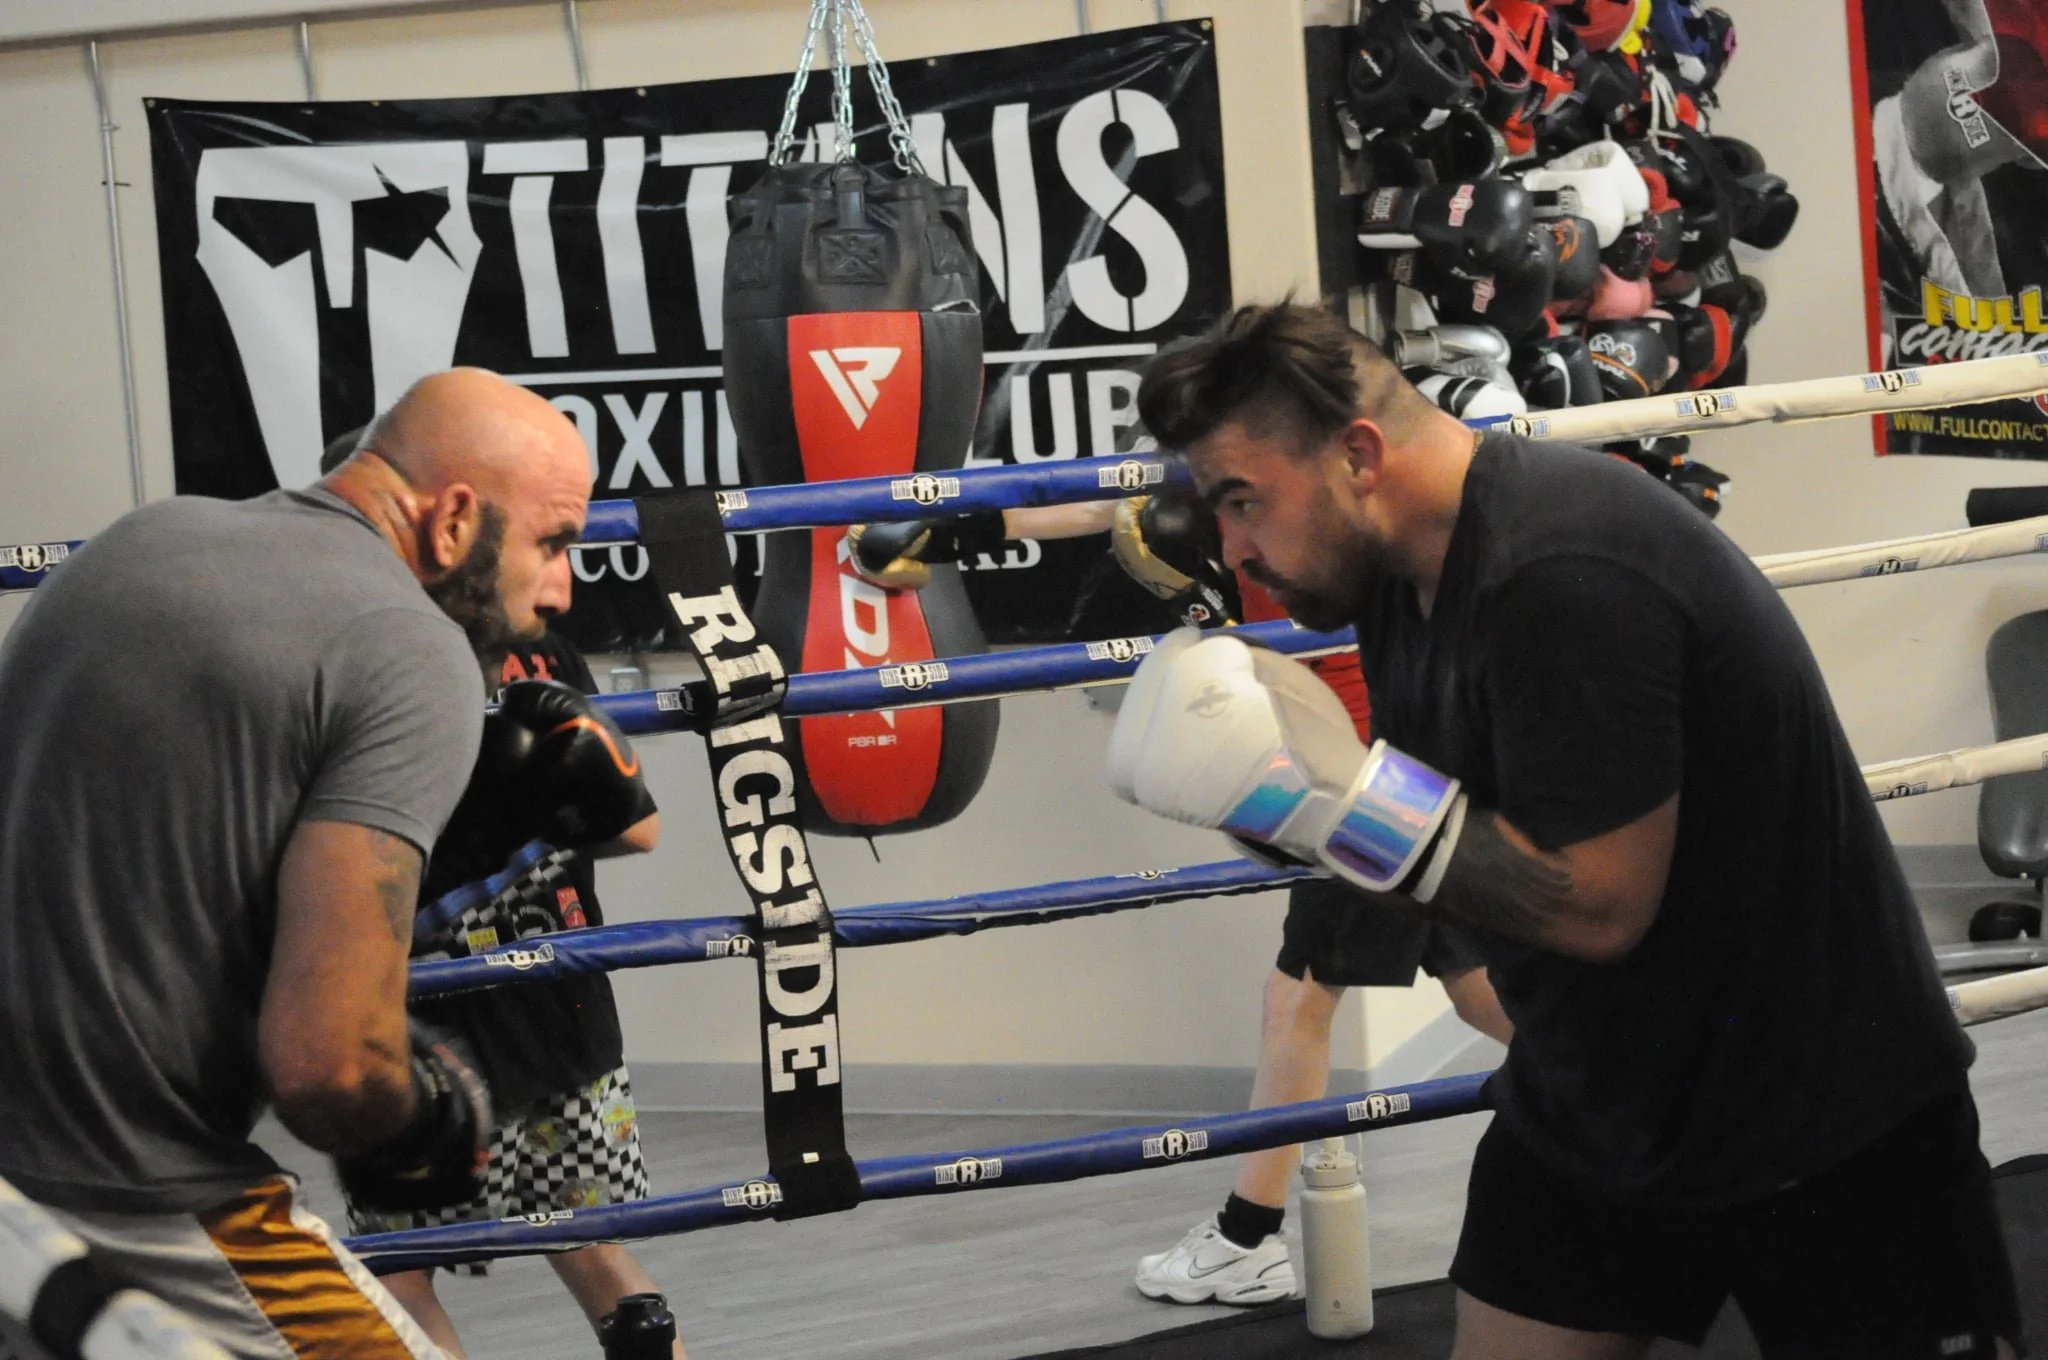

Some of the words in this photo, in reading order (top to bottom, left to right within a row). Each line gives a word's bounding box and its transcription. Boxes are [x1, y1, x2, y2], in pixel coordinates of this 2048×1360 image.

[483, 88, 1189, 358] TITNS
[1121, 463, 1142, 488] R
[914, 476, 938, 502] R
[21, 544, 42, 568] R
[902, 664, 926, 688] R
[1369, 1095, 1390, 1119] R
[1165, 1131, 1186, 1157] R
[959, 1160, 980, 1184] R
